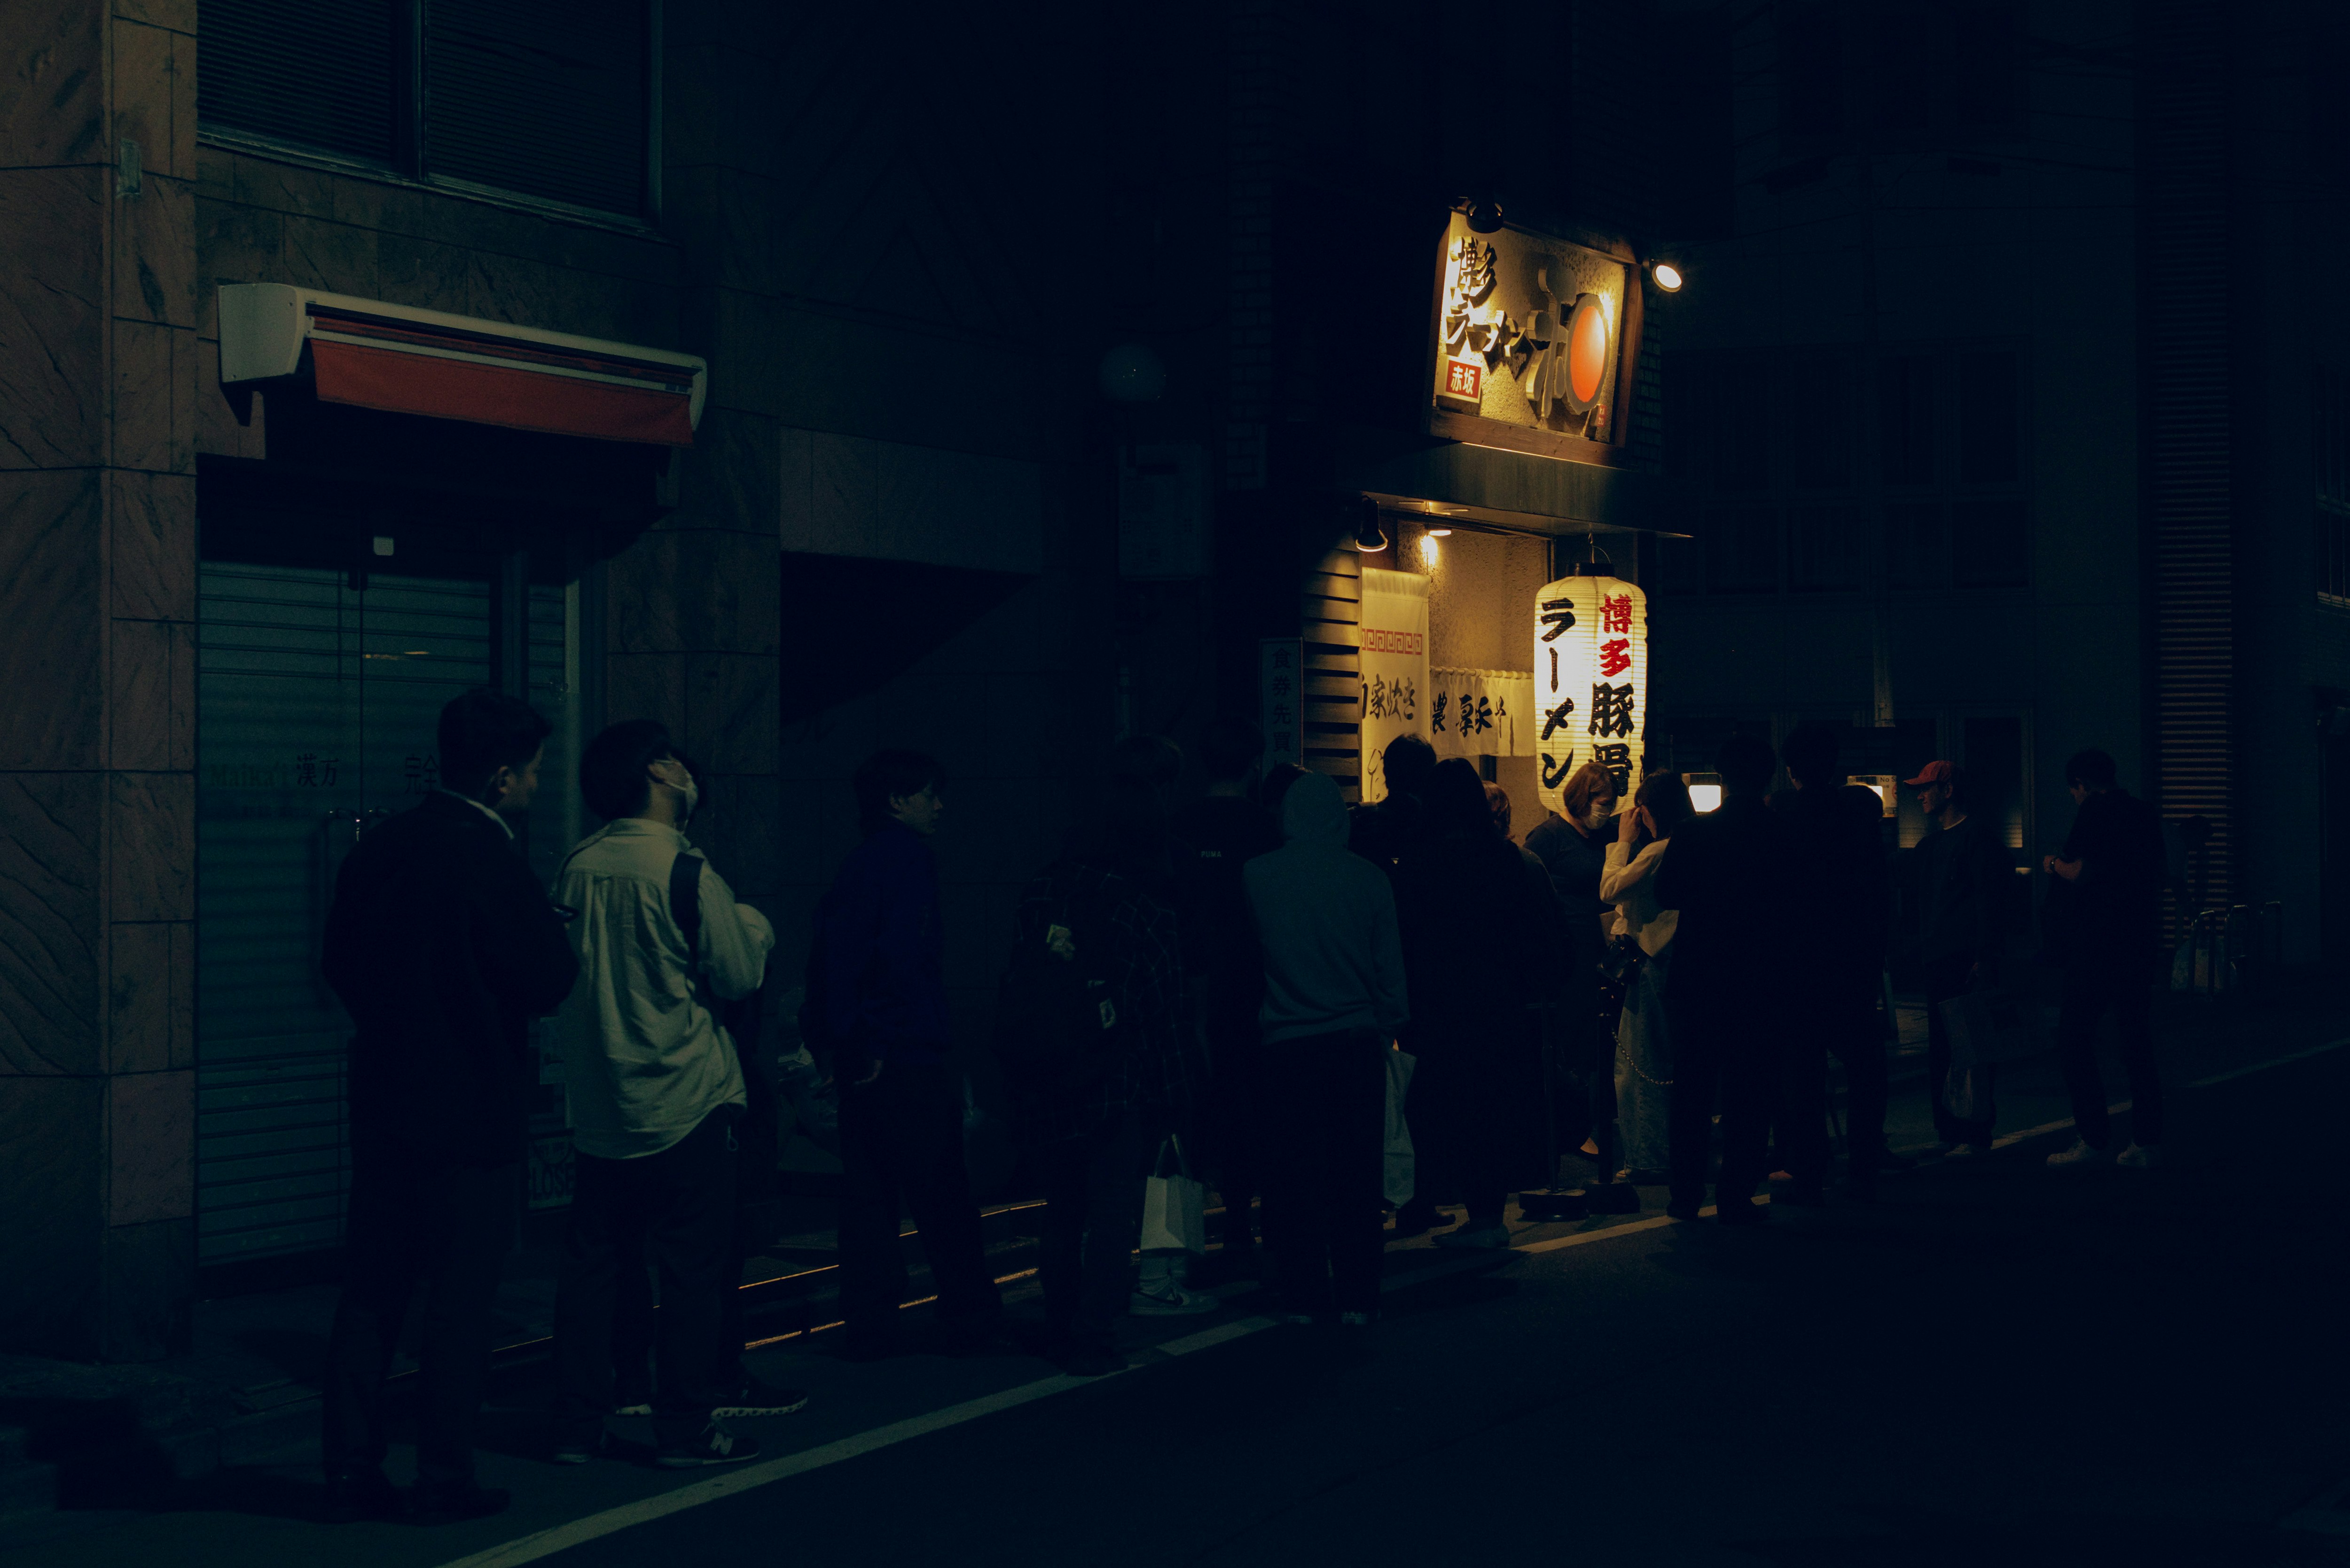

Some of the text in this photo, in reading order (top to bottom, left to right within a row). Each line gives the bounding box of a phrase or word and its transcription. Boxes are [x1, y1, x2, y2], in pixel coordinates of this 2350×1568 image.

[1450, 365, 1476, 395] 赤坂
[1271, 647, 1292, 768] 食券先買
[1362, 673, 1415, 723] 家炊き
[1540, 597, 1575, 790] ラーメン
[296, 752, 339, 788] 漢方
